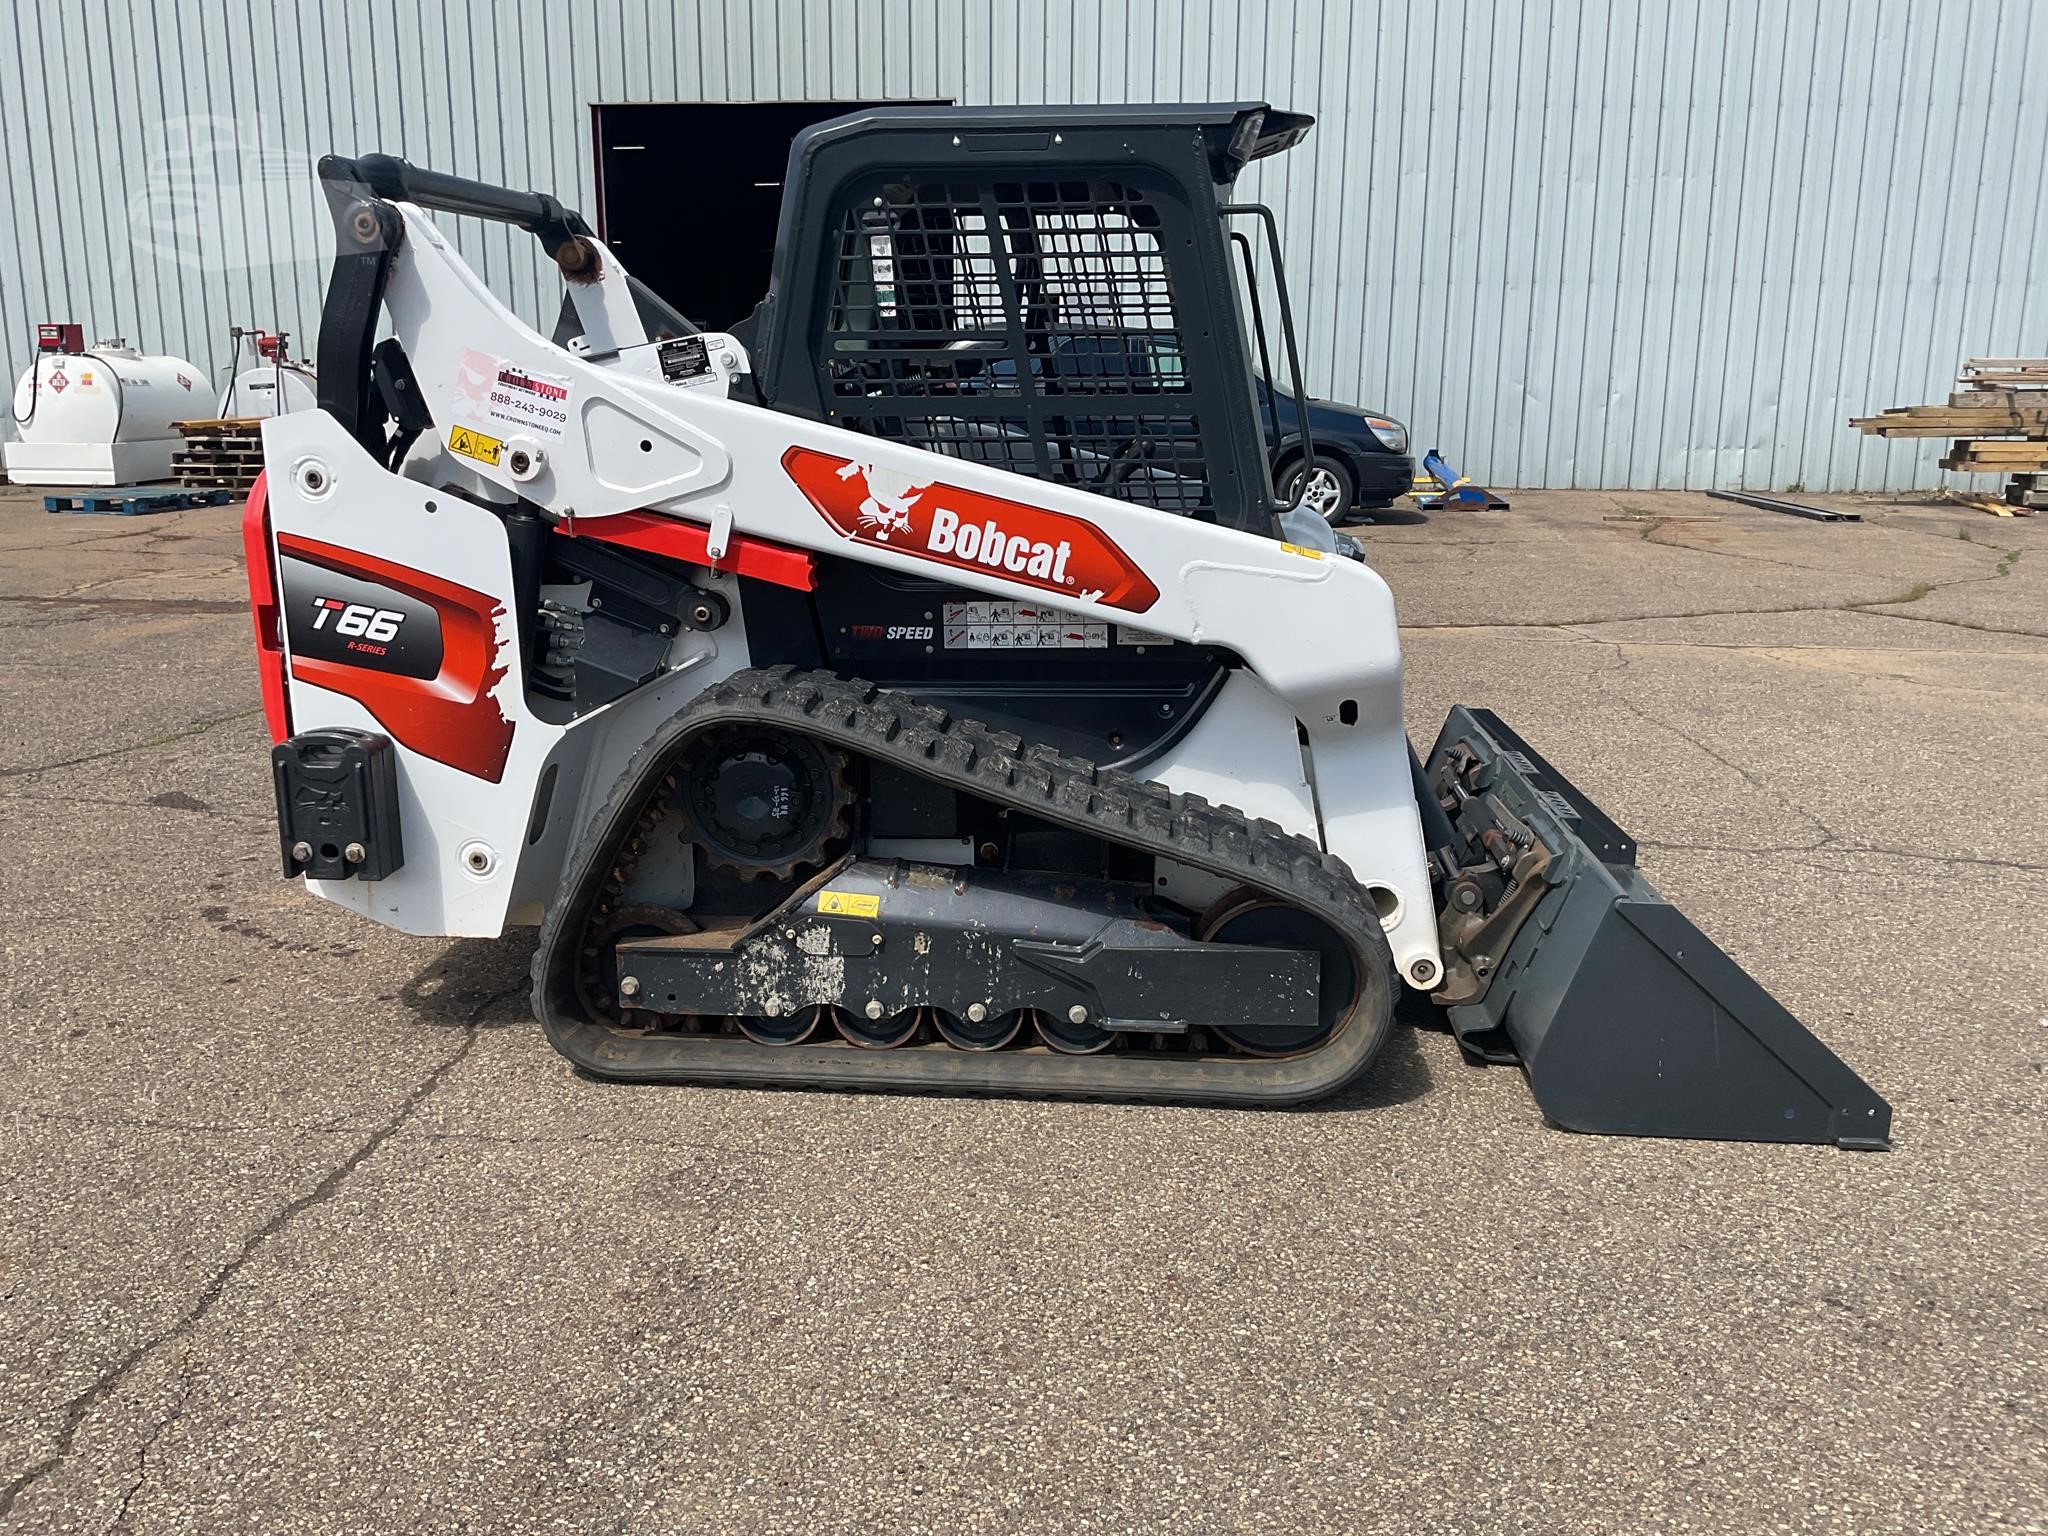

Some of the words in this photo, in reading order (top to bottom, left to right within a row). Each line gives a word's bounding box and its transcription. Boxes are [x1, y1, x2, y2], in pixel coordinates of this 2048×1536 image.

[490, 392, 567, 423] 888-243-9029
[490, 411, 562, 435] WWW.CROWNSTONEEQ.COM
[927, 507, 1071, 583] Bobcat
[312, 597, 406, 643] T66
[886, 626, 934, 640] SPEED
[347, 641, 387, 656] R-SERIES
